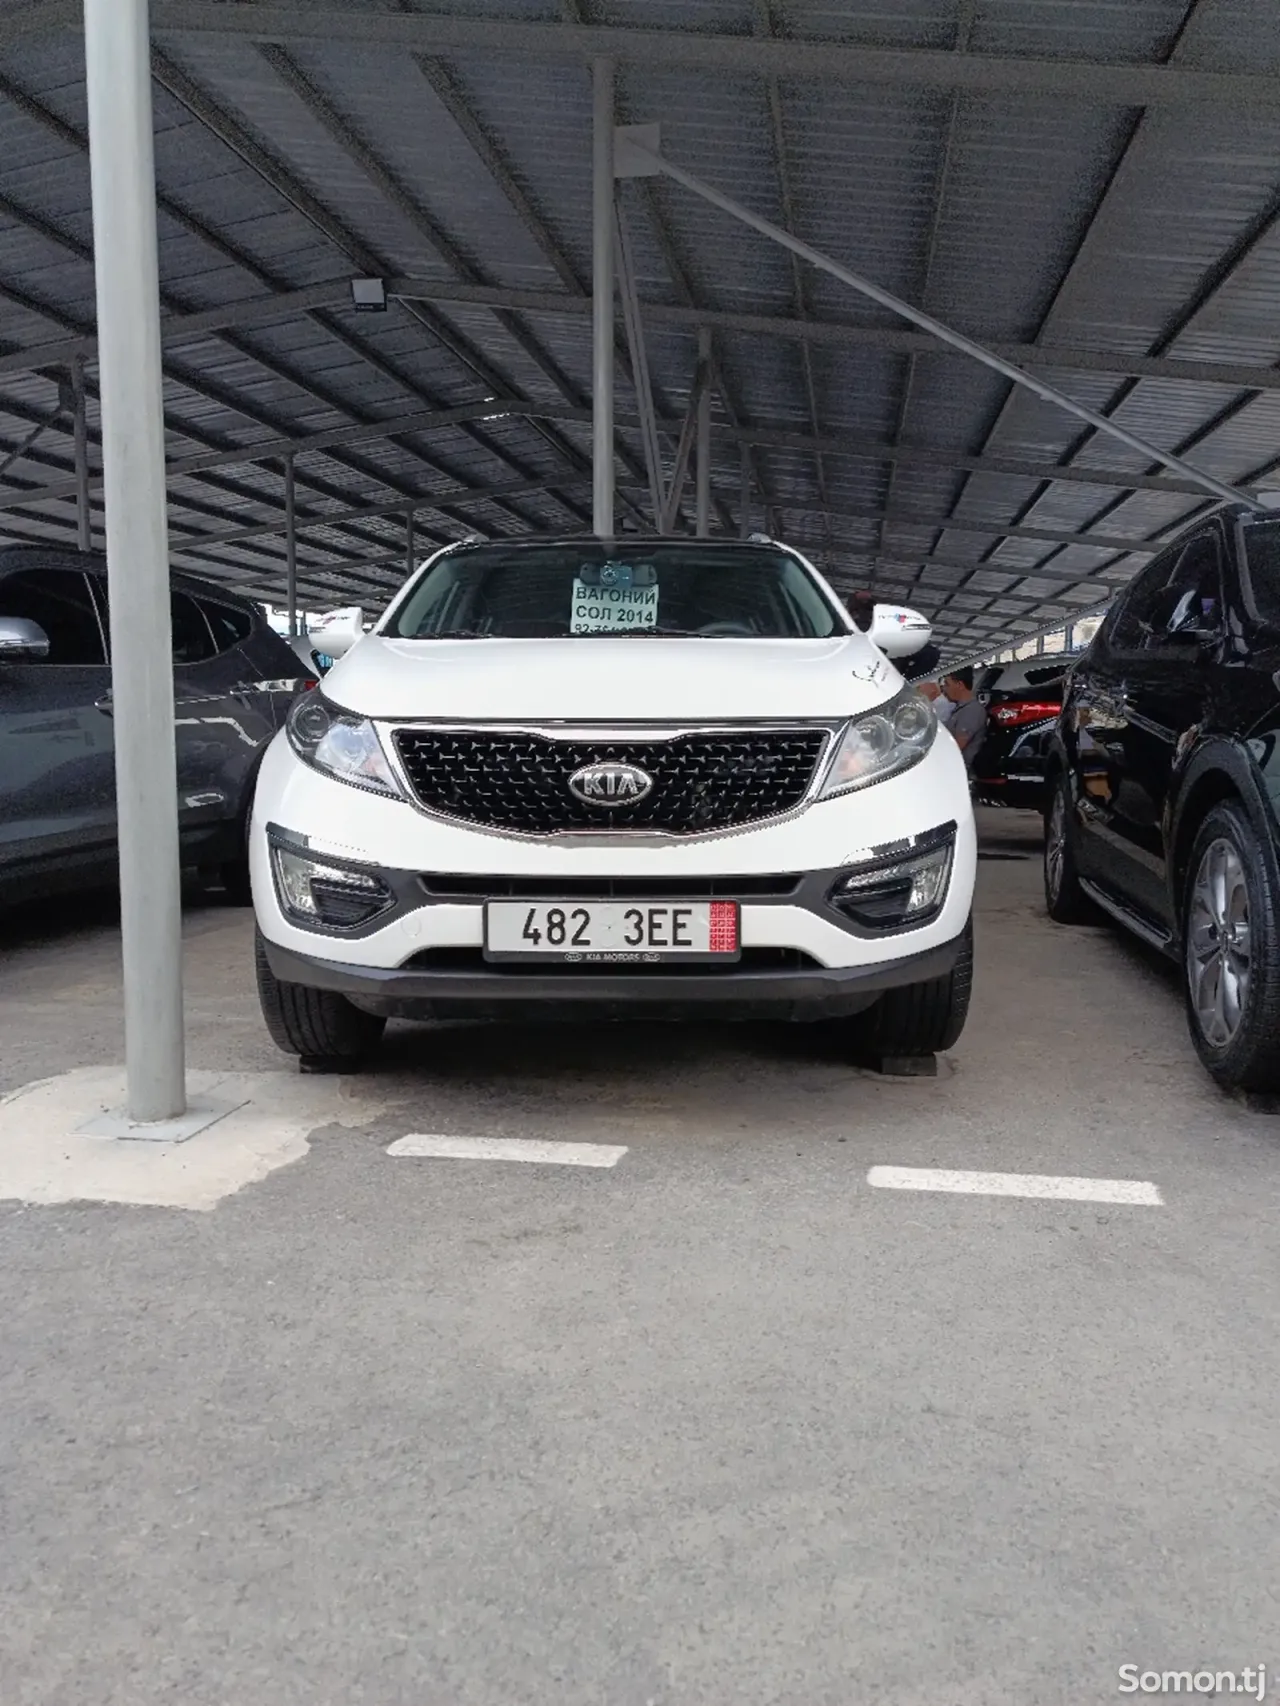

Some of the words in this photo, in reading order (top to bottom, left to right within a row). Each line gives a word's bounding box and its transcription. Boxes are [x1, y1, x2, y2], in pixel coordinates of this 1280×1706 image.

[575, 586, 656, 605] ВАГОНИЙ
[576, 605, 612, 620] СОЛ
[617, 608, 654, 623] 2014
[583, 772, 640, 795] KIA
[522, 908, 591, 946] 482
[623, 908, 693, 947] 3EE
[603, 953, 640, 961] MOTORS
